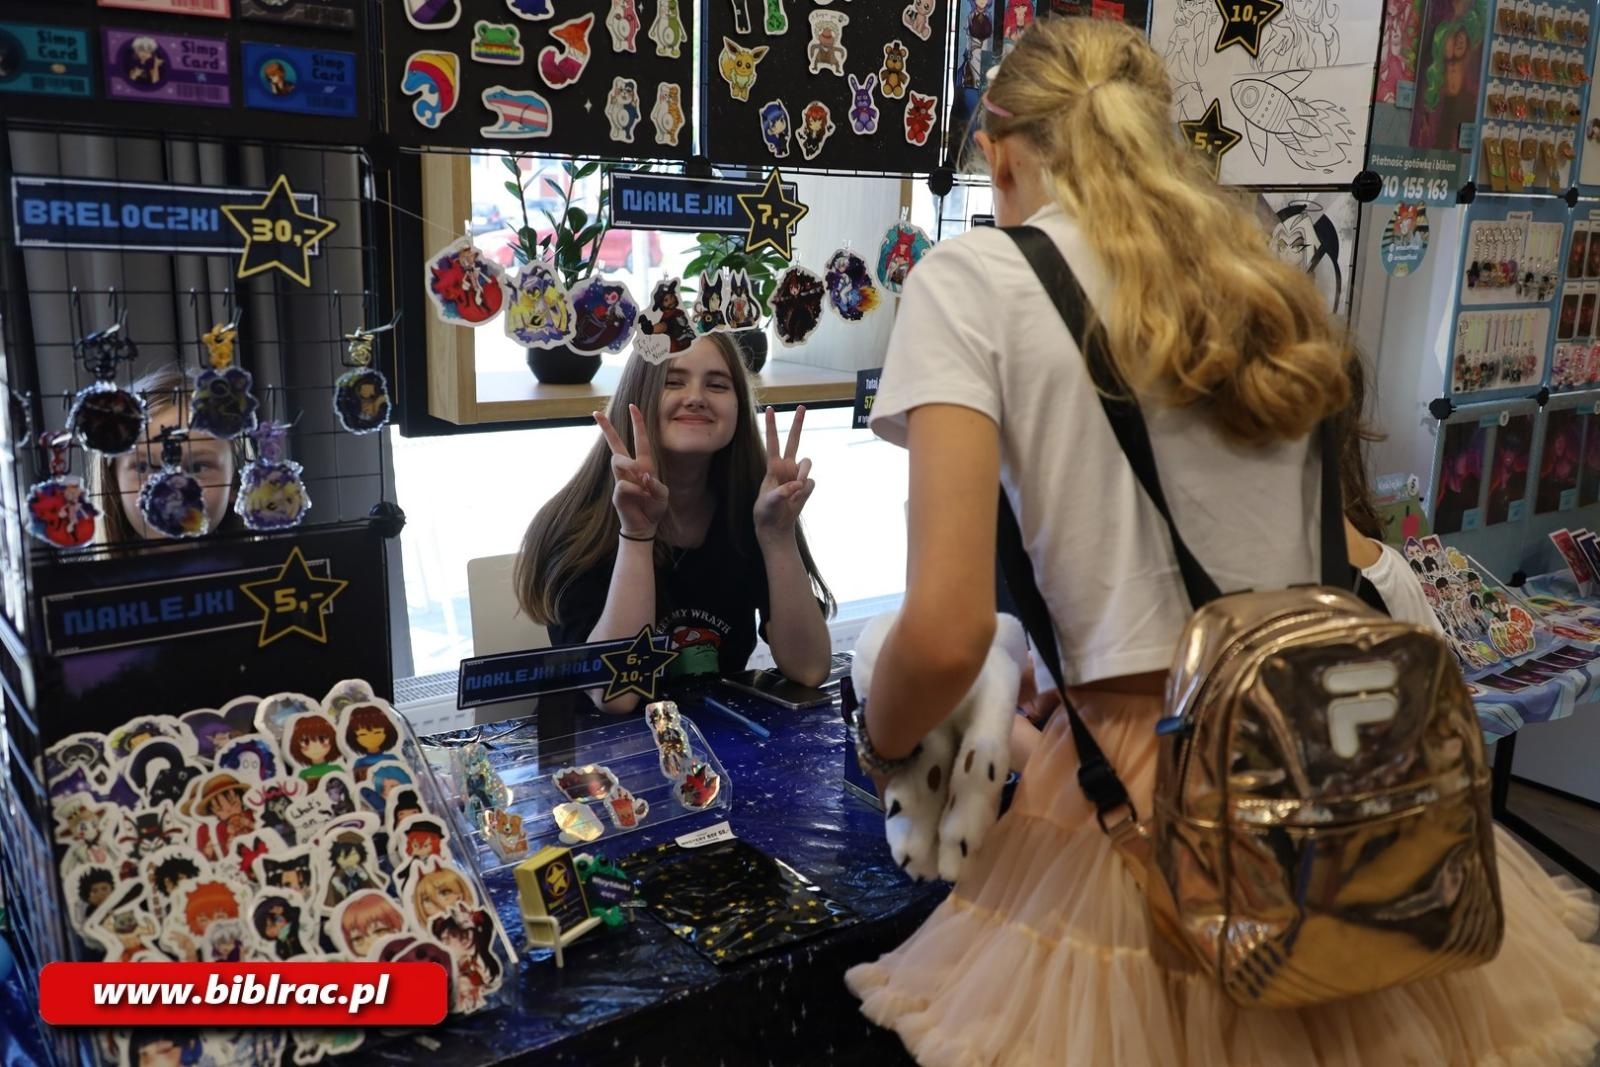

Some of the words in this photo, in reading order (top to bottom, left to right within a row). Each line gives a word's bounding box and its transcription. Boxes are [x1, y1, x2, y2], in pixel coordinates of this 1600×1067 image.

[37, 30, 76, 48] Simp
[181, 40, 218, 57] Simp
[37, 45, 78, 61] Card
[181, 54, 219, 70] Card
[312, 54, 345, 71] Simp
[312, 67, 345, 82] Card
[1380, 174, 1399, 198] 10
[1402, 176, 1425, 199] 155
[1427, 178, 1449, 201] 163
[622, 188, 733, 217] NAKLEJKI
[23, 199, 219, 232] BRELOCZKI
[63, 588, 235, 637] NAKLEJKI
[672, 609, 687, 618] MY
[692, 608, 731, 634] WRATH
[465, 666, 555, 691] NAKLEJKI
[562, 658, 602, 678] HOLO
